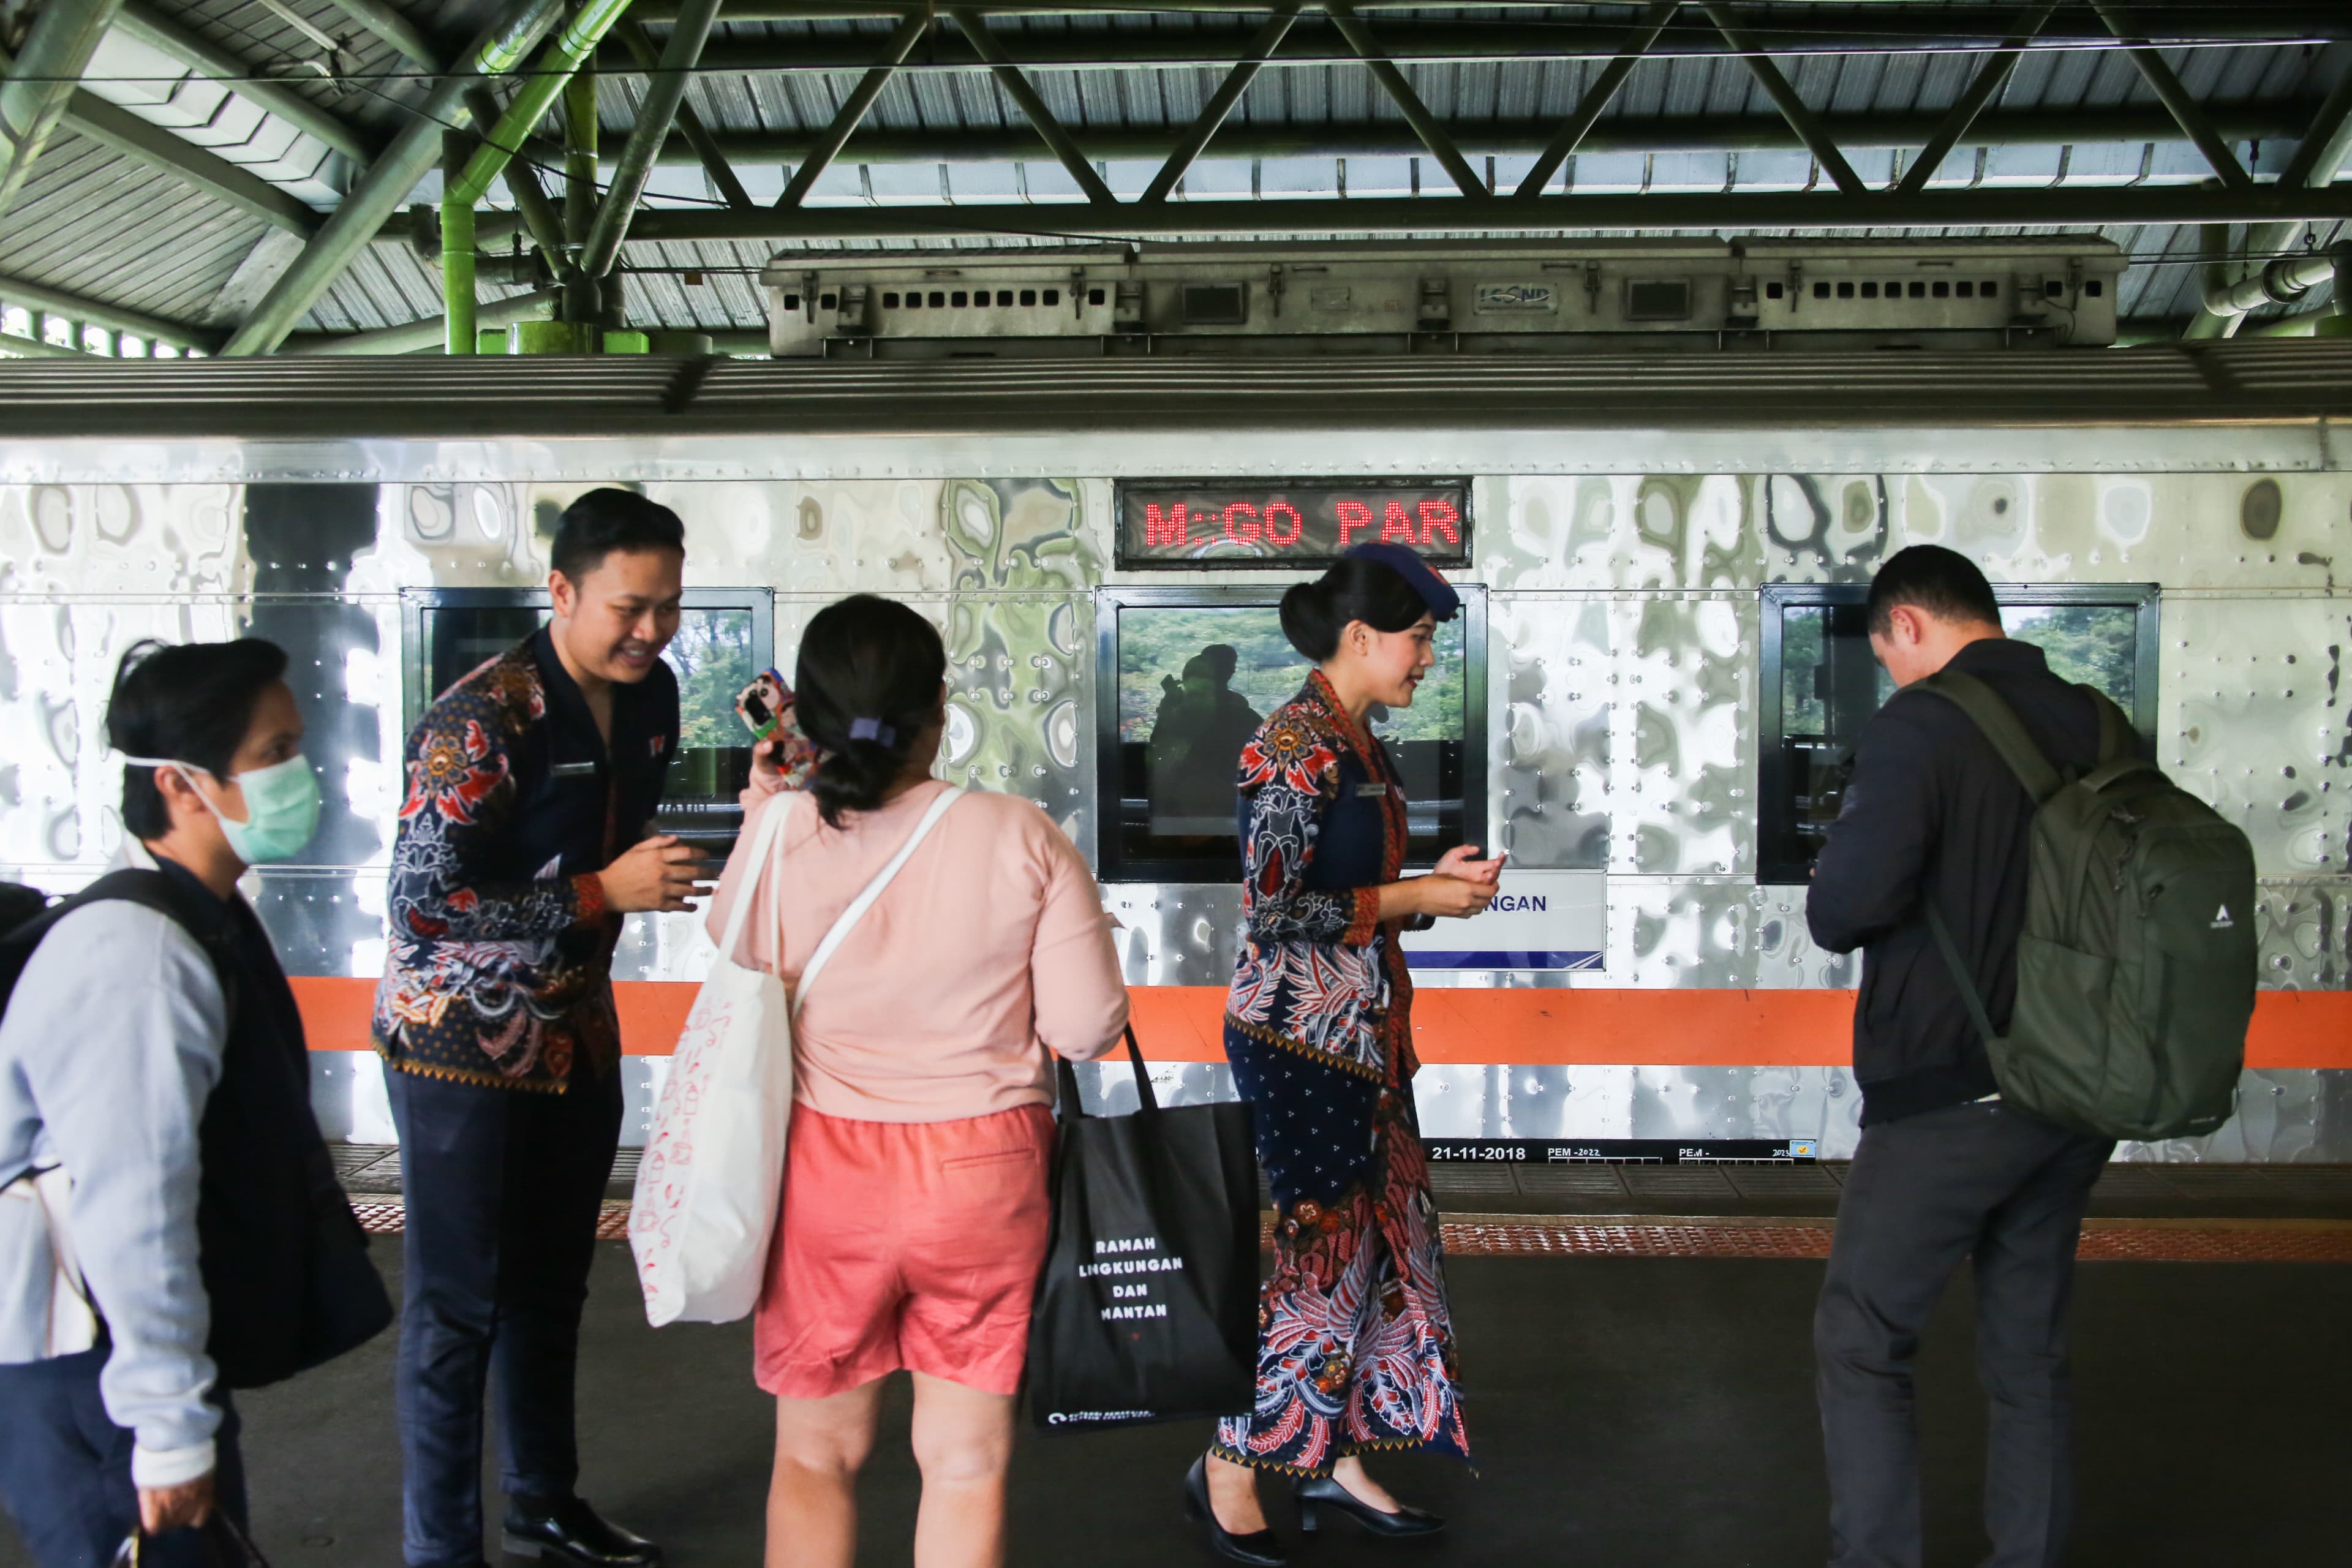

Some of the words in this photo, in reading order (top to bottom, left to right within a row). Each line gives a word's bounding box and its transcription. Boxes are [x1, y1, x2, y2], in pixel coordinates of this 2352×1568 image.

[1336, 501, 1459, 545] PAR
[1432, 1147, 1526, 1160] 21-11-2018
[1548, 1148, 1571, 1156] PEM
[1096, 1237, 1156, 1254] RAMAH
[1112, 1284, 1147, 1298] DAN
